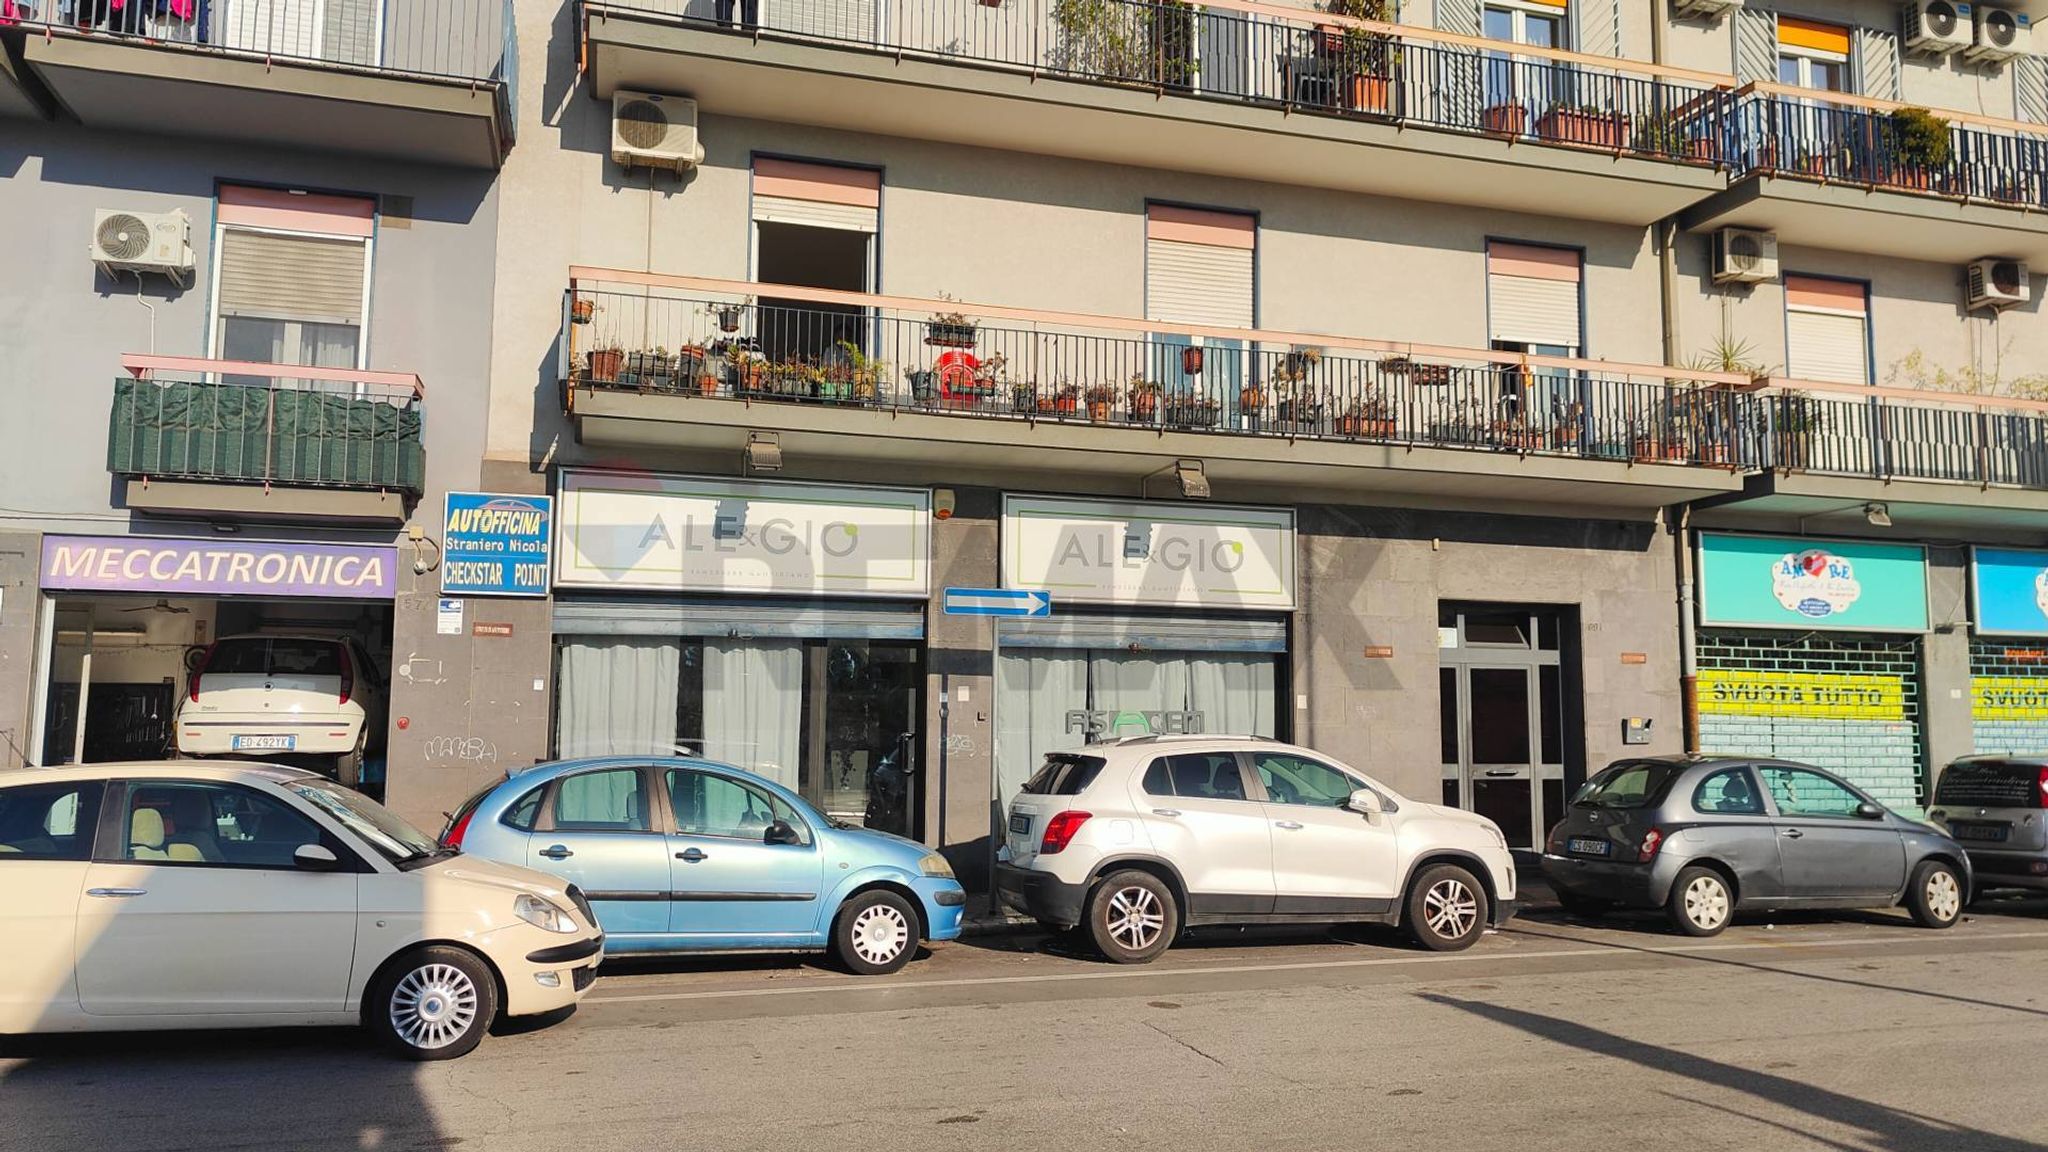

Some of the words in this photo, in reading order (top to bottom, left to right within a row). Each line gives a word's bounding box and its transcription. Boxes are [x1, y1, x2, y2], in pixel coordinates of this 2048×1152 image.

[447, 508, 541, 535] AUTOFFICINA
[446, 537, 504, 552] Straniero
[509, 539, 548, 553] Nicola
[50, 546, 384, 587] MECCATRONICA
[444, 561, 503, 585] CHECKSTAR
[514, 563, 548, 586] POINT
[1713, 682, 1803, 705] SVUOTA
[1811, 686, 1883, 707] TUTTO
